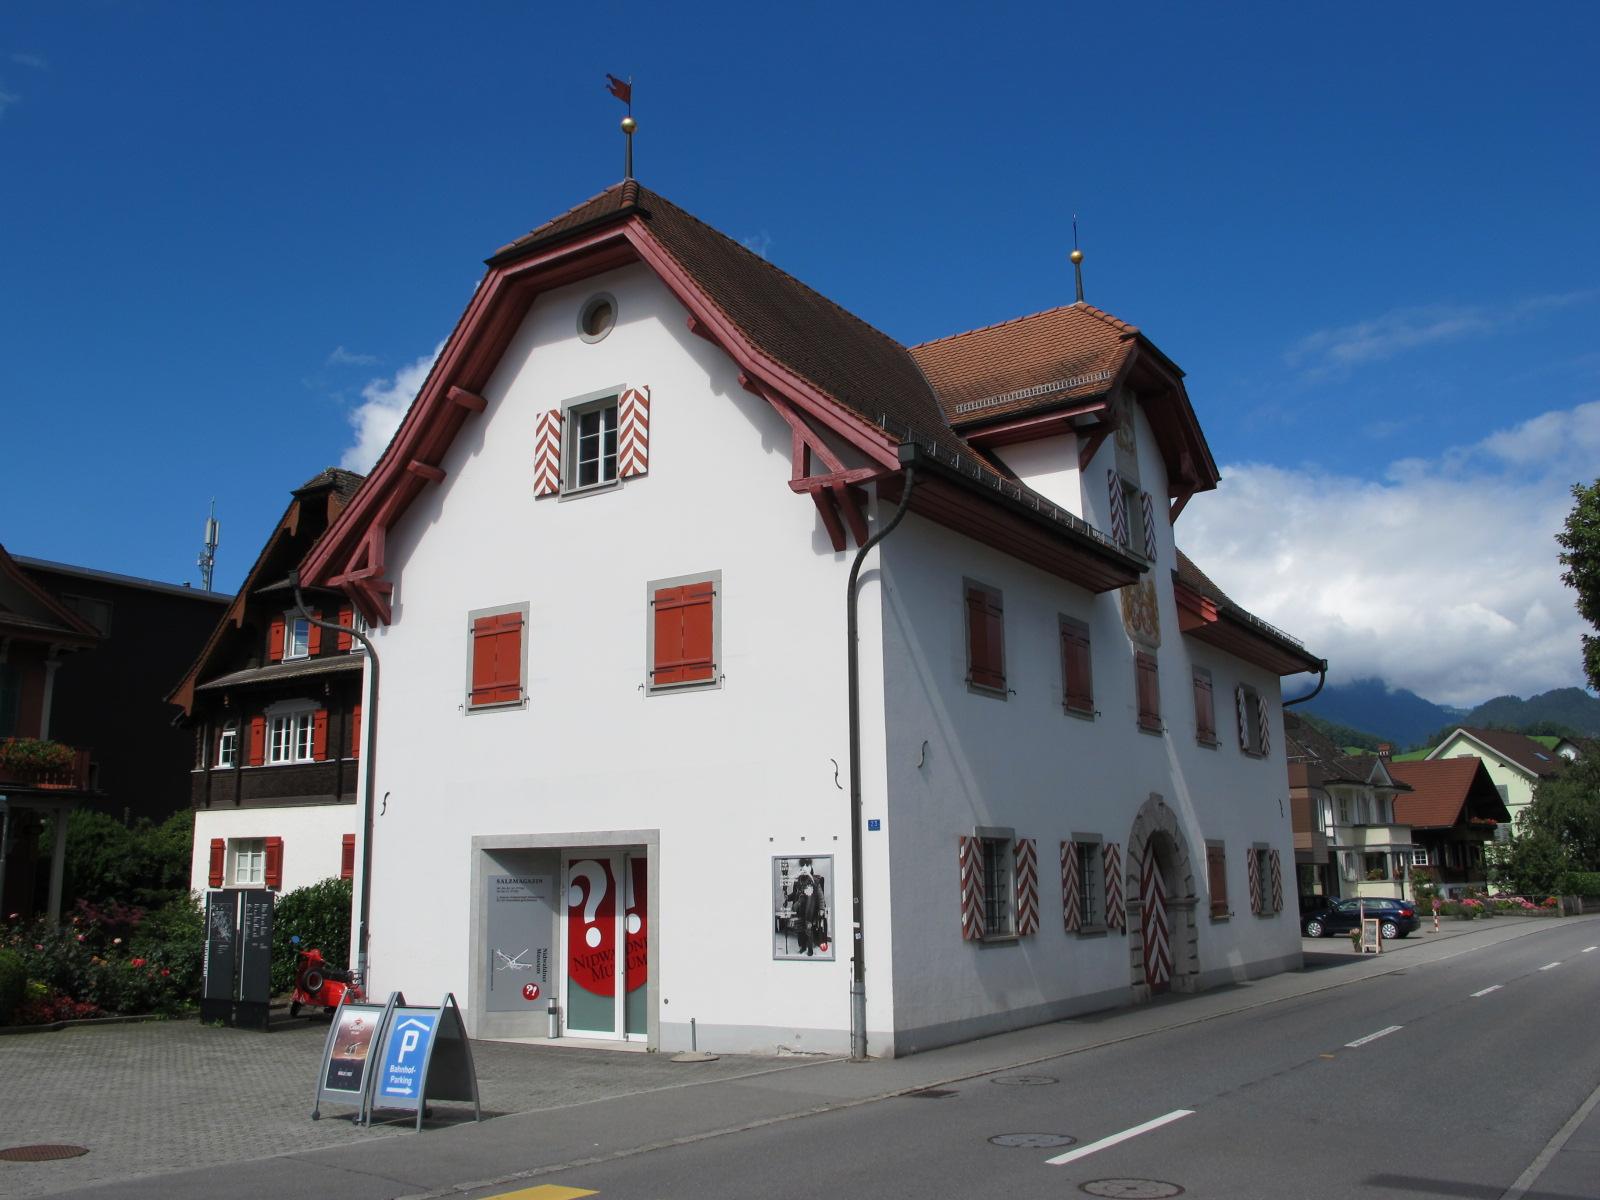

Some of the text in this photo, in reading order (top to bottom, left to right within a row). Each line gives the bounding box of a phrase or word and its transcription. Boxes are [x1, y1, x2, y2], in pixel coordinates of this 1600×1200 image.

[398, 1030, 419, 1063] P
[389, 1064, 416, 1074] Bahnhof-
[390, 1075, 412, 1086] Parking
